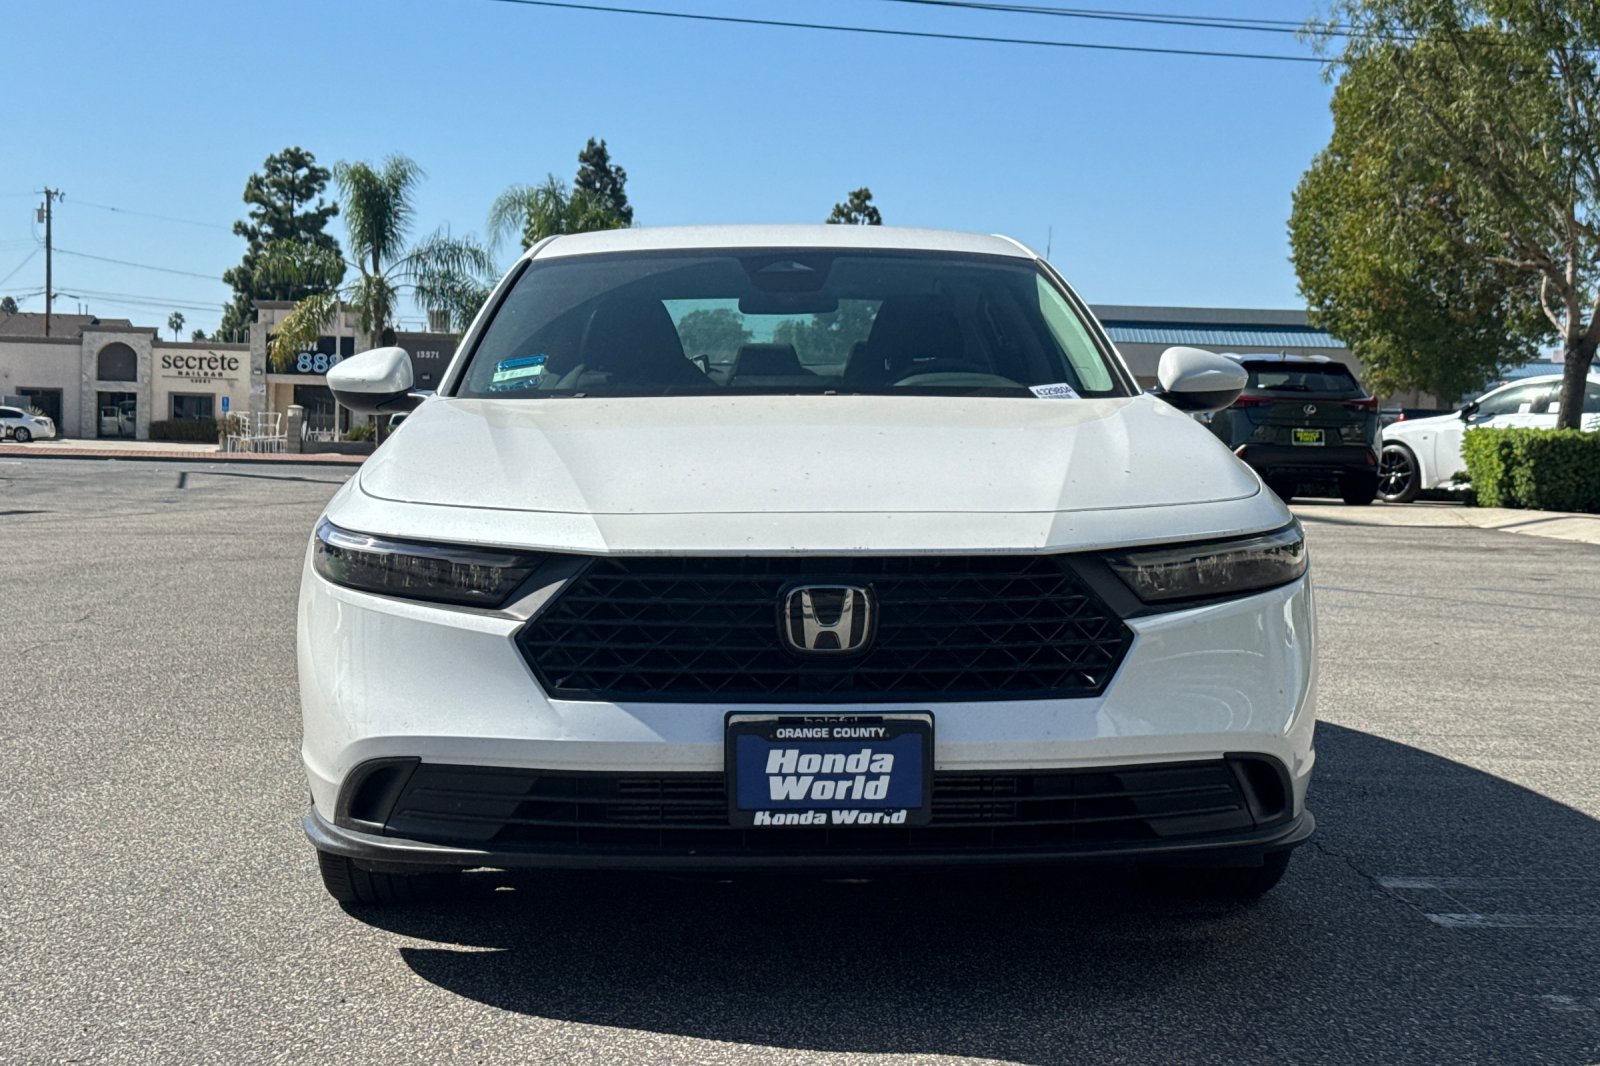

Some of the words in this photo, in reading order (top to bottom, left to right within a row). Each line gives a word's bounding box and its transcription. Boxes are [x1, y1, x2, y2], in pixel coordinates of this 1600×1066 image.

[161, 350, 239, 371] secrète
[776, 728, 829, 738] ORANGE
[833, 727, 885, 738] COUNTY
[765, 749, 894, 774] Honda
[768, 775, 890, 801] World
[753, 810, 827, 826] Honda
